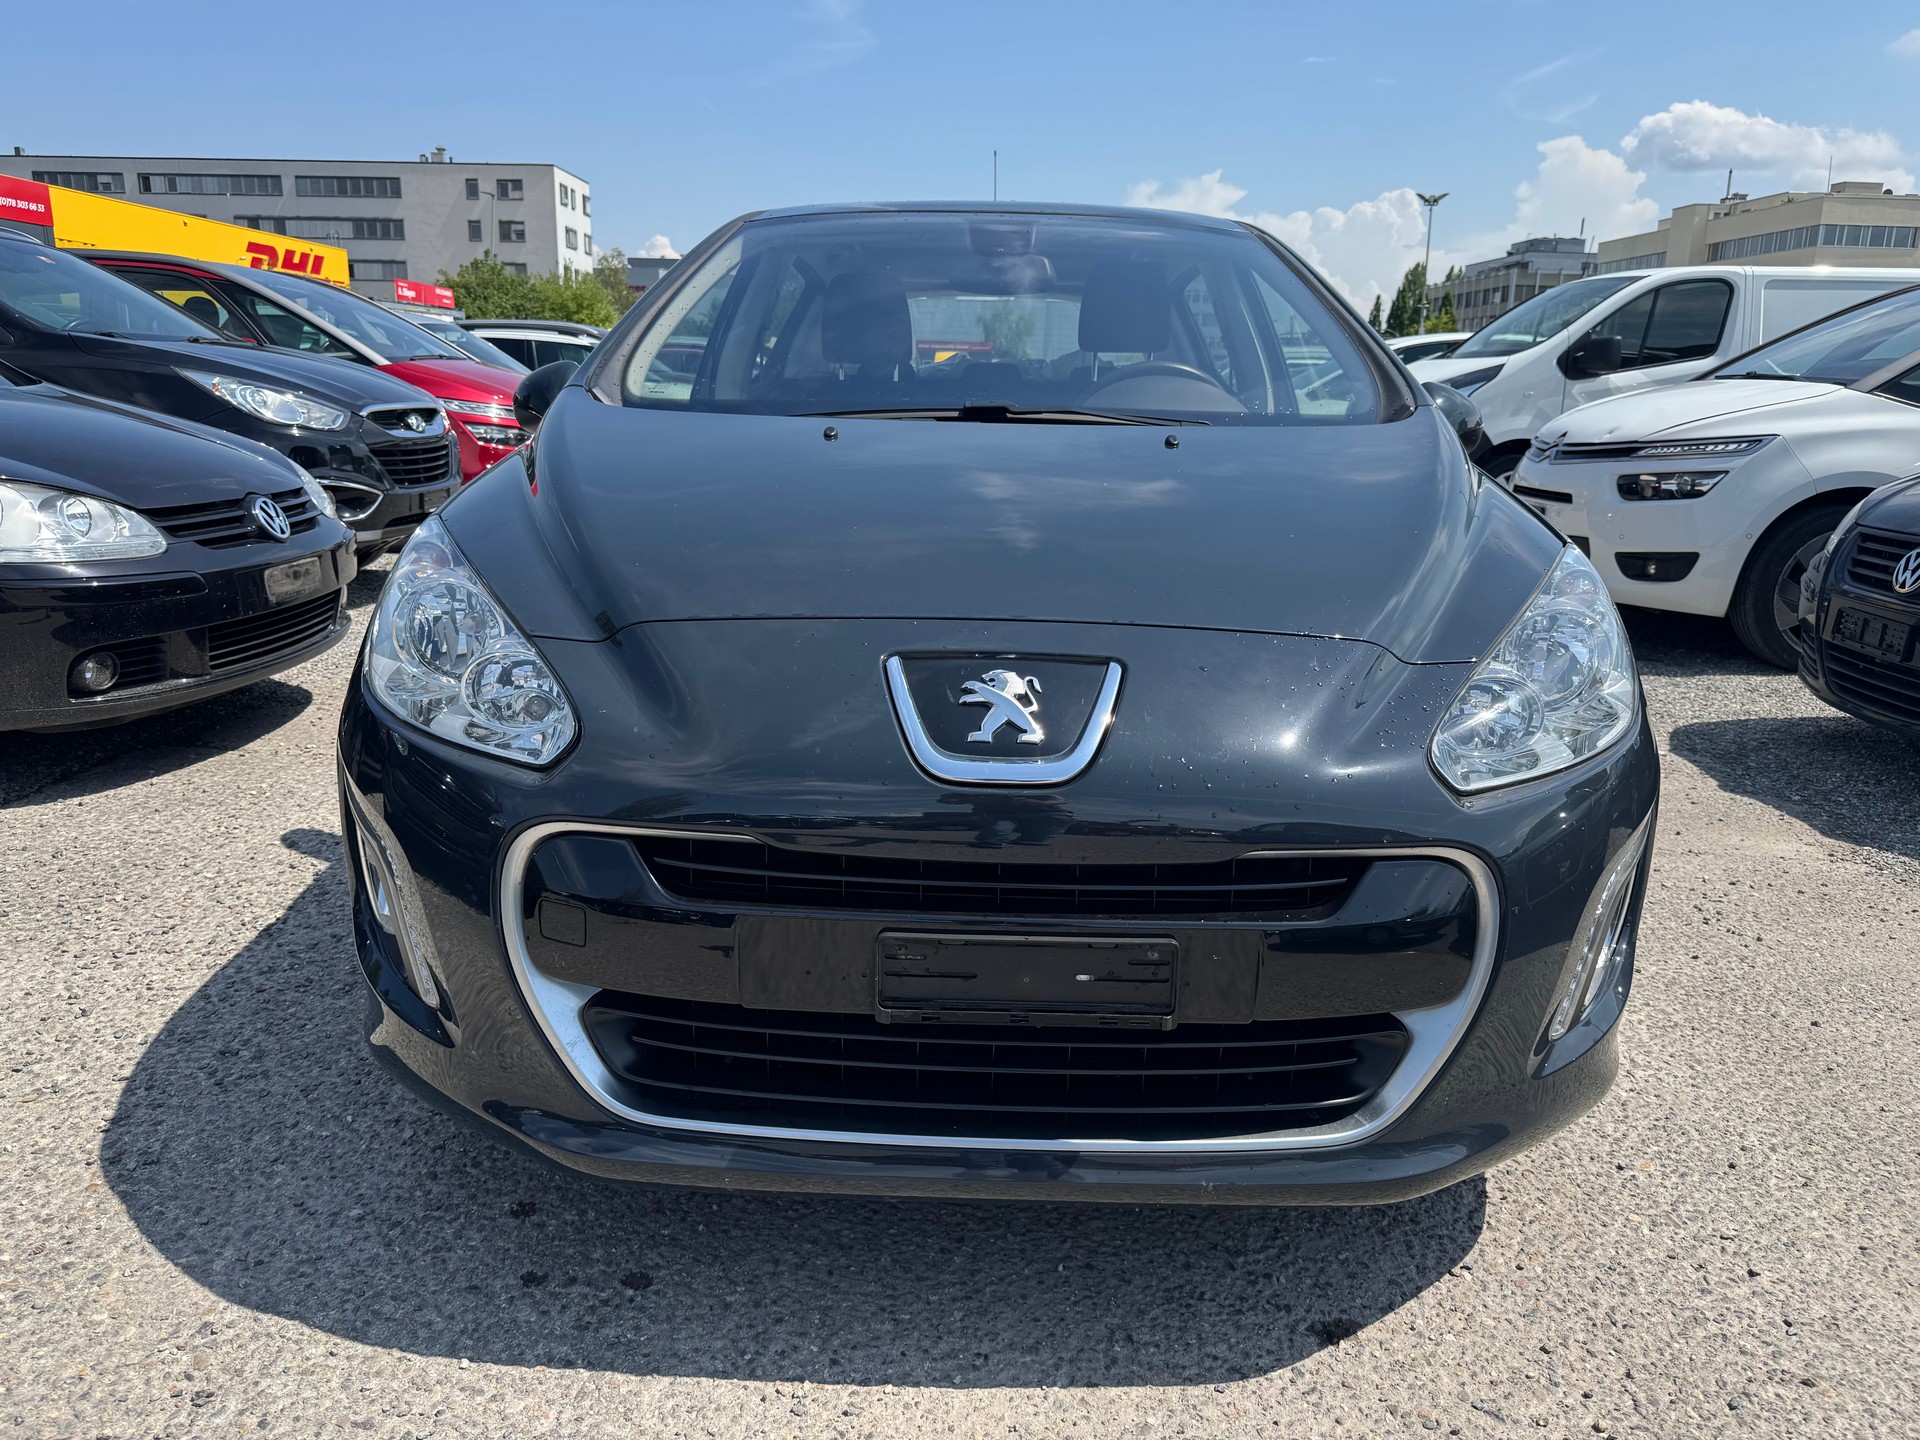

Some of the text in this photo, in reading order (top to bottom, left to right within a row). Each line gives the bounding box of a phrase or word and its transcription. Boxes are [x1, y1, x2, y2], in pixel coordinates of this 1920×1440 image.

[17, 200, 28, 209] 303
[29, 202, 37, 211] 66
[37, 204, 45, 212] 33
[246, 241, 326, 278] DHL
[254, 497, 290, 539] VW
